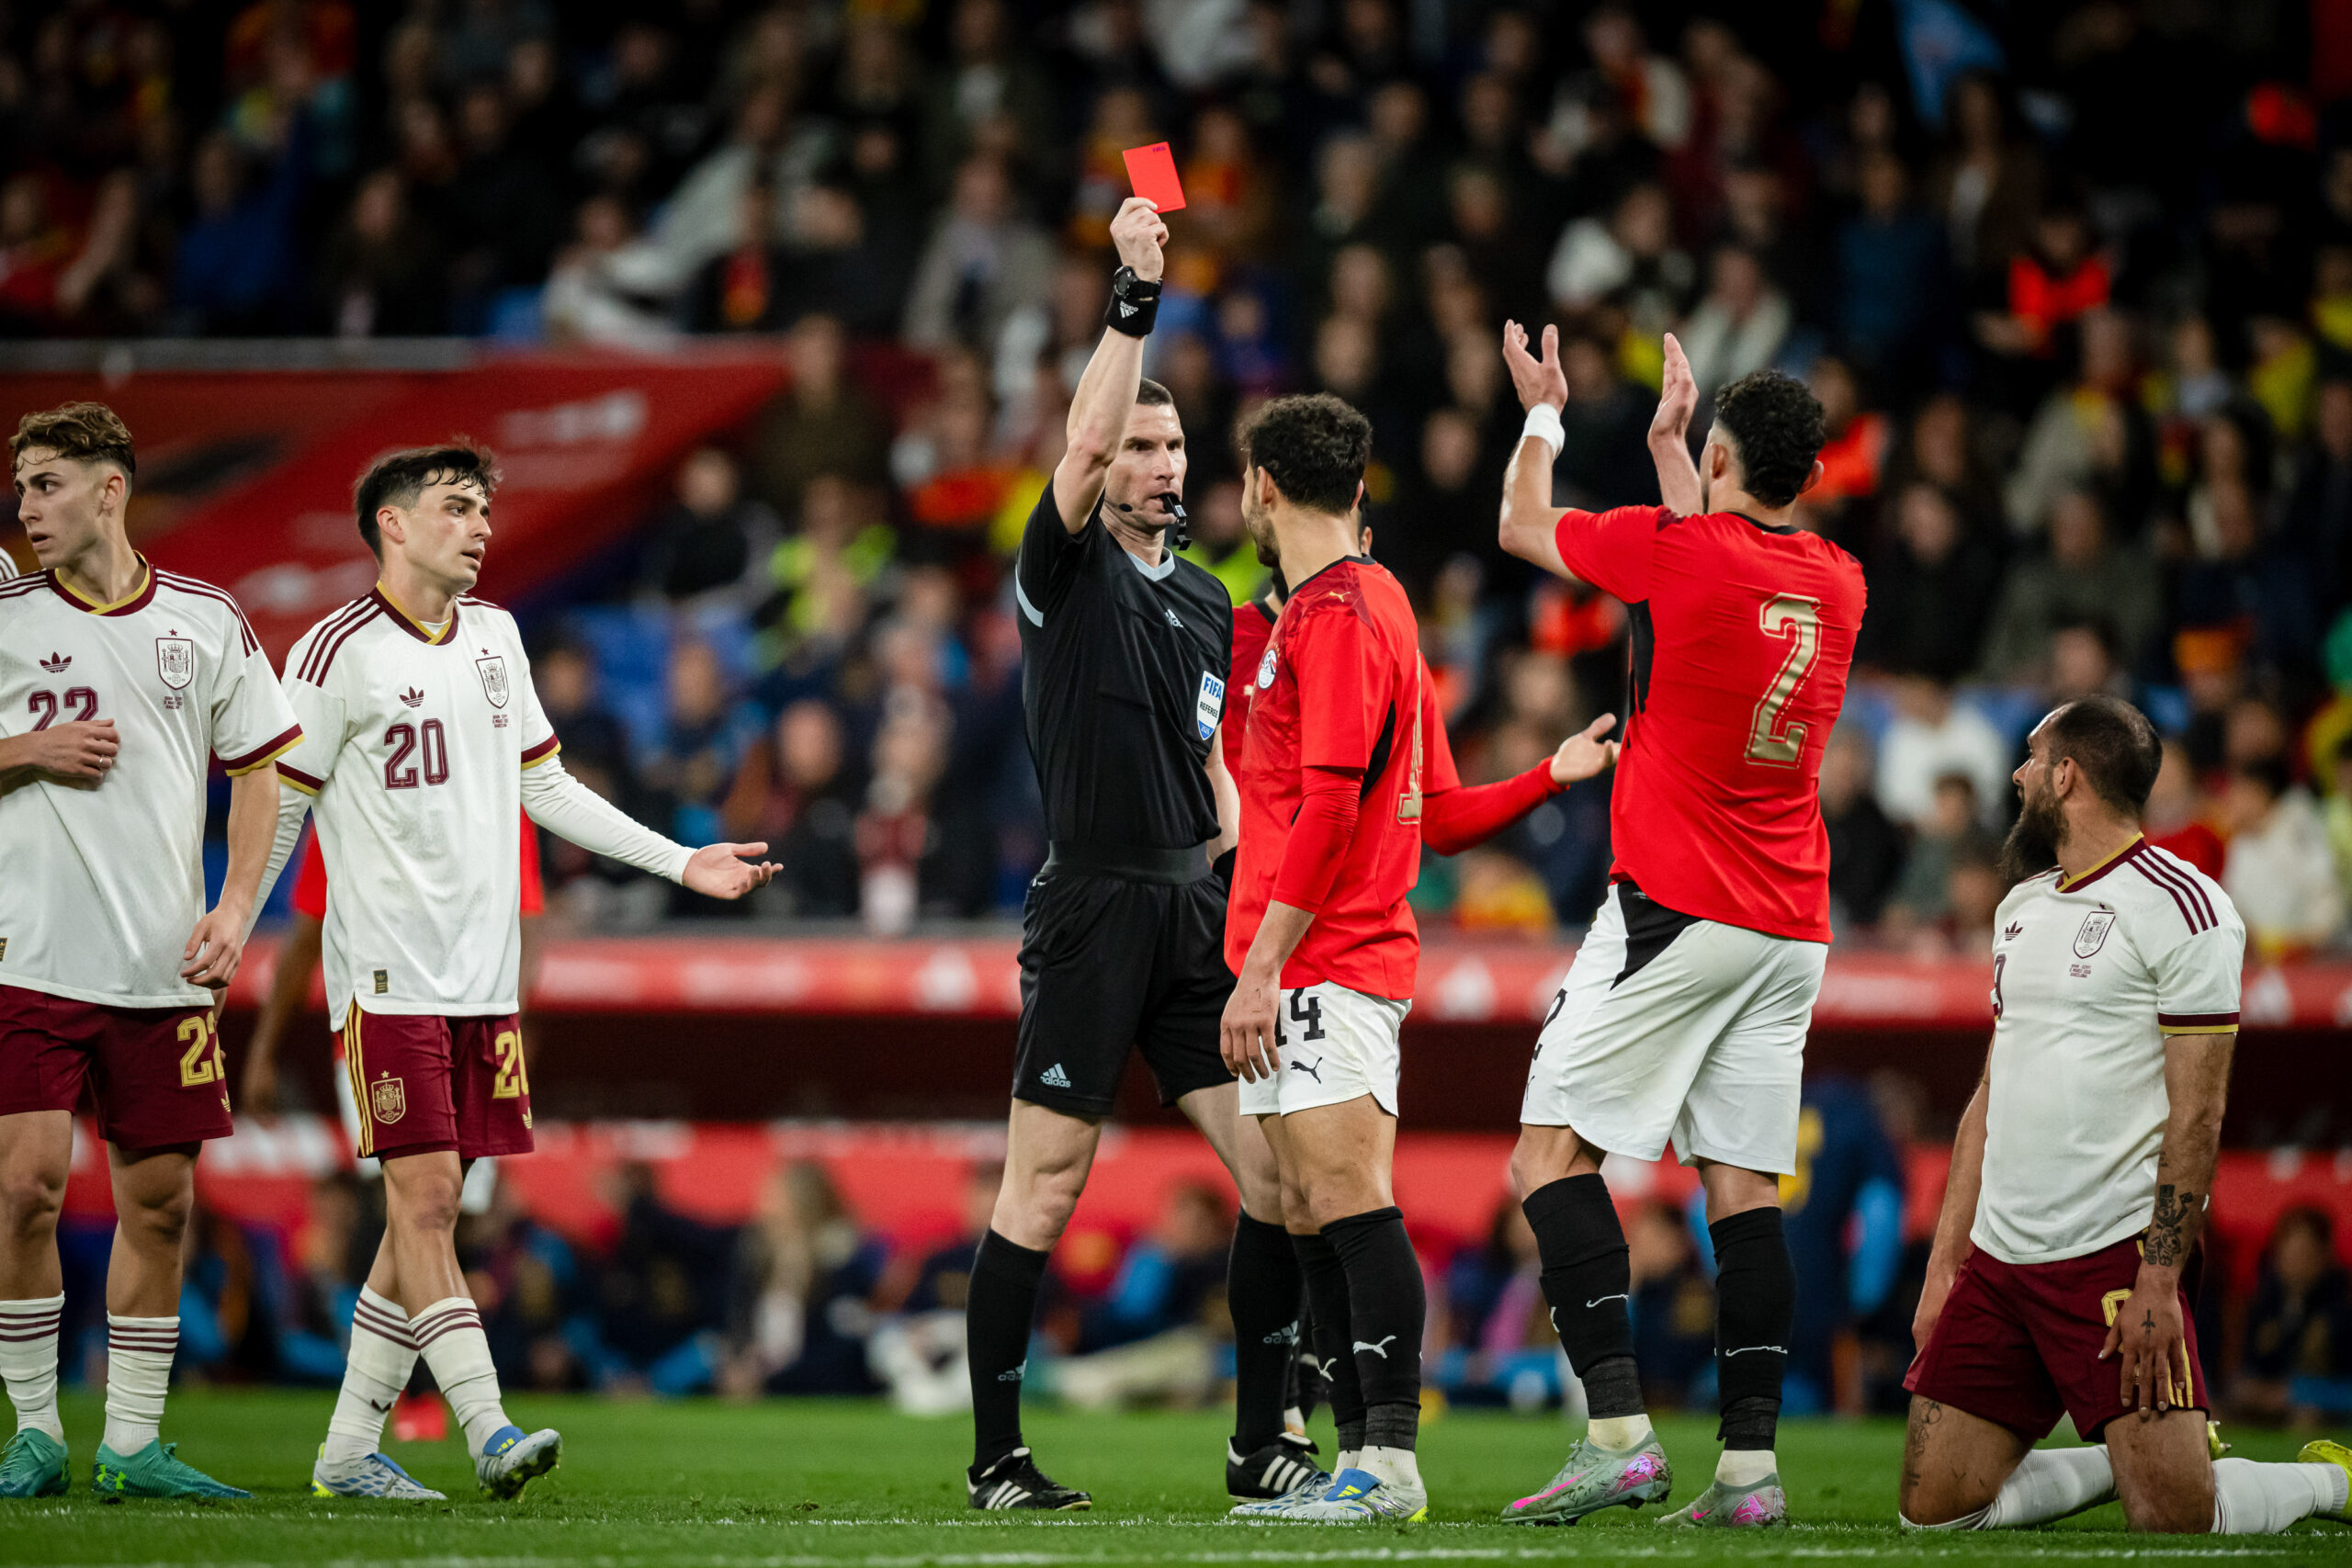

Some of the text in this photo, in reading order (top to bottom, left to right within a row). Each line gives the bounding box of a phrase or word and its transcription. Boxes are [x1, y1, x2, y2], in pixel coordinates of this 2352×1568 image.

[1204, 676, 1222, 701] FIFA
[1744, 592, 1823, 770] 2
[28, 686, 99, 732] 22
[1200, 701, 1218, 718] REFEREE
[384, 717, 450, 790] 20
